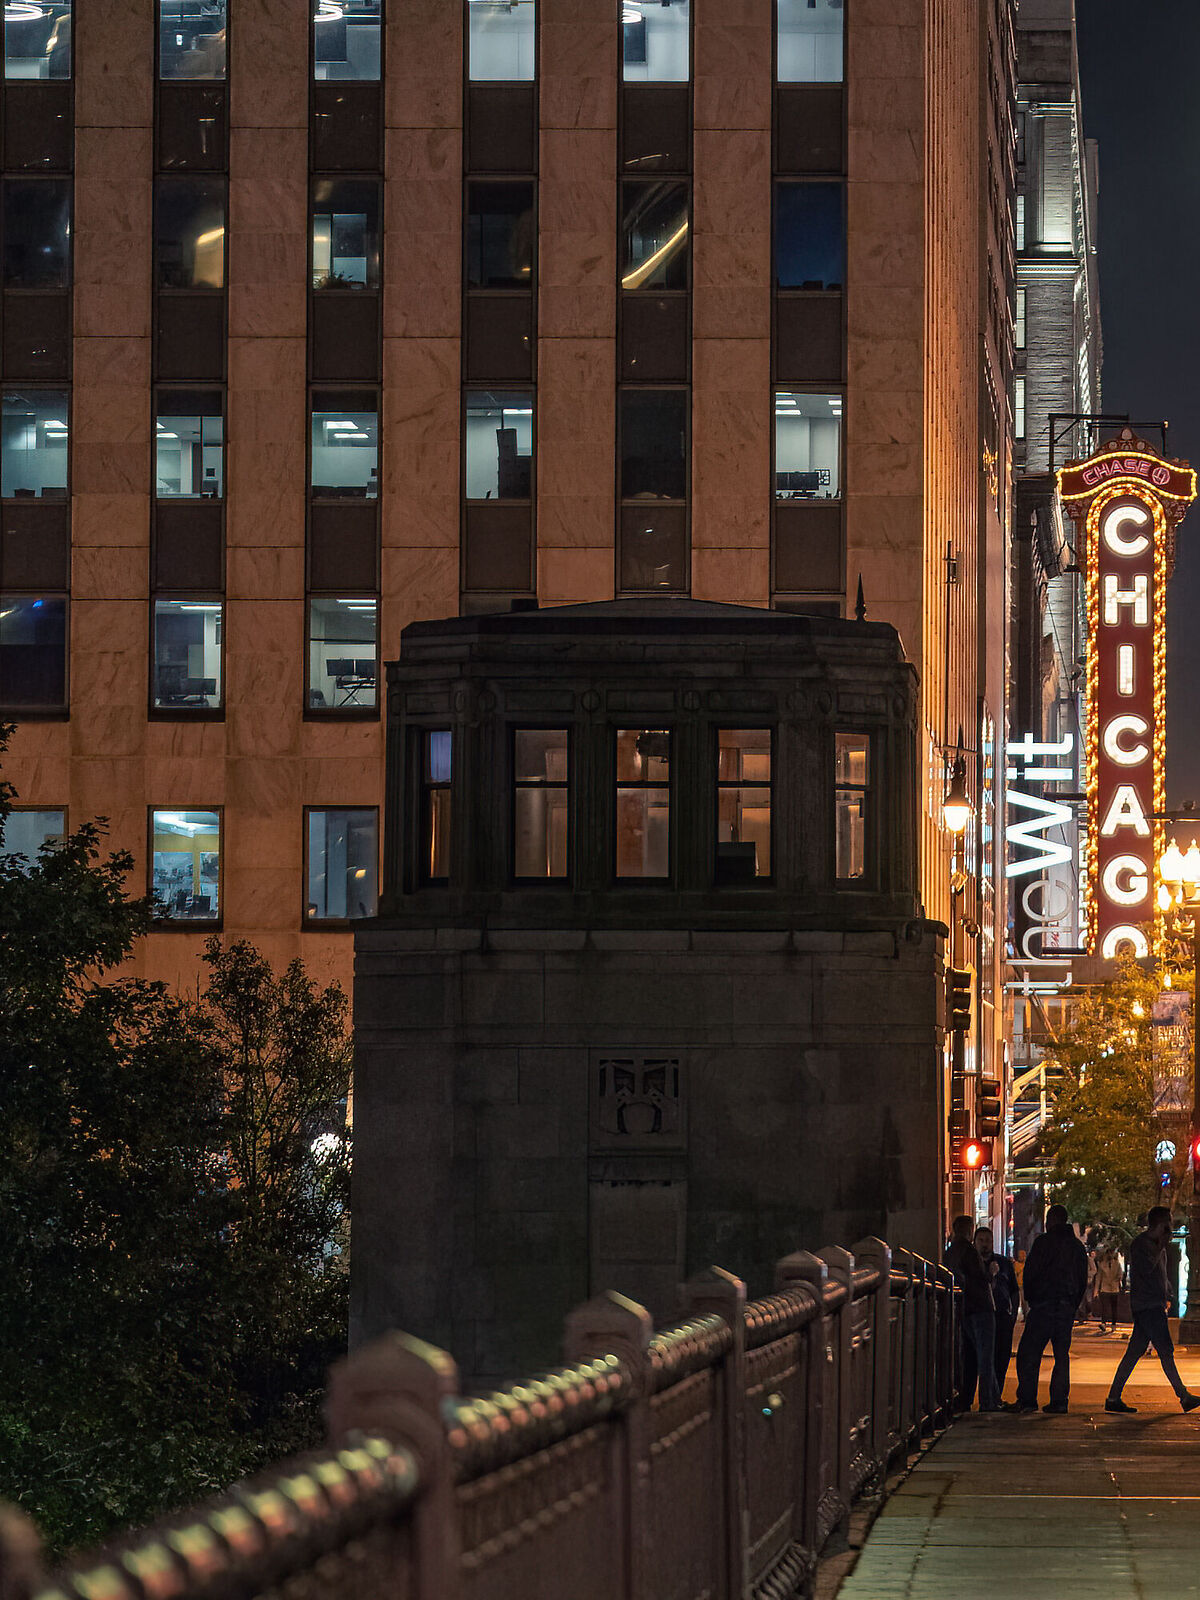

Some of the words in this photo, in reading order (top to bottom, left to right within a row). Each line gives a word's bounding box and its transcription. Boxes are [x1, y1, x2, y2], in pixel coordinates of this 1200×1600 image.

[1082, 458, 1151, 486] CHASE
[1101, 505, 1151, 960] CHICAGO
[1158, 1025, 1185, 1036] EVERY
